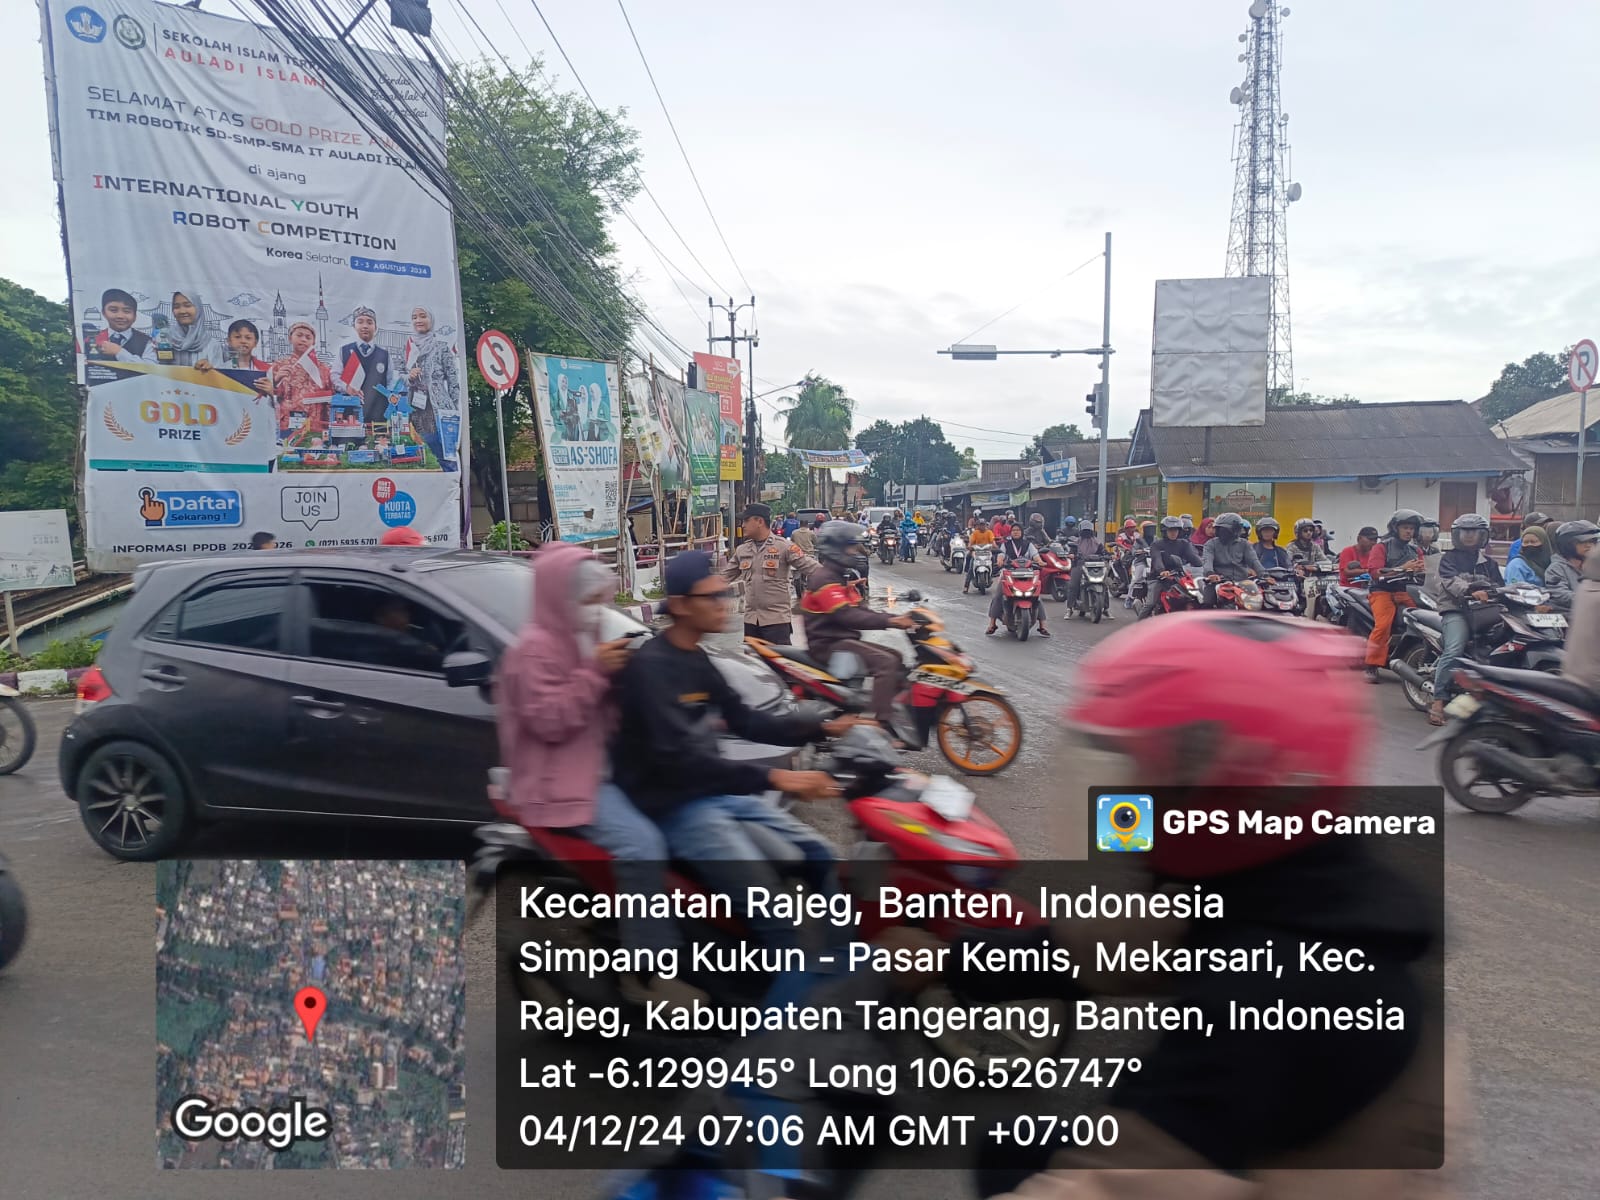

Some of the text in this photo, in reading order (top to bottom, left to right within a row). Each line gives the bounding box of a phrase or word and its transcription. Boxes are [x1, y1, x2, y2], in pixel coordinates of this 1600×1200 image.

[162, 29, 232, 53] SEKOLAH
[237, 46, 280, 63] ISLAM
[164, 47, 244, 74] AULADI
[87, 86, 186, 113] SELAMAT
[193, 105, 245, 128] ATAS
[251, 116, 302, 137] GOLD
[308, 126, 363, 146] PRIZE
[86, 108, 121, 123] TIM
[126, 113, 202, 136] ROBOTIK
[205, 127, 305, 155] SD-SMP-SMA
[309, 147, 324, 158] IT
[329, 150, 382, 164] AULADI
[248, 164, 307, 185] di ajang
[92, 174, 360, 220] INTERNATIONAL YOUTH
[172, 210, 398, 251] ROBOT COMPETITION
[266, 247, 304, 260] Korea
[373, 262, 407, 273] AGUSTUS
[1577, 351, 1590, 381] P
[140, 400, 218, 427] GOLD
[158, 428, 201, 441] PRIZE
[169, 495, 236, 511] Daftar
[295, 491, 327, 504] JOIN
[384, 501, 411, 512] KUOTA
[171, 513, 221, 522] Sekarang
[301, 505, 321, 517] US
[113, 544, 187, 553] INFORMASI
[193, 543, 227, 552] PPDB
